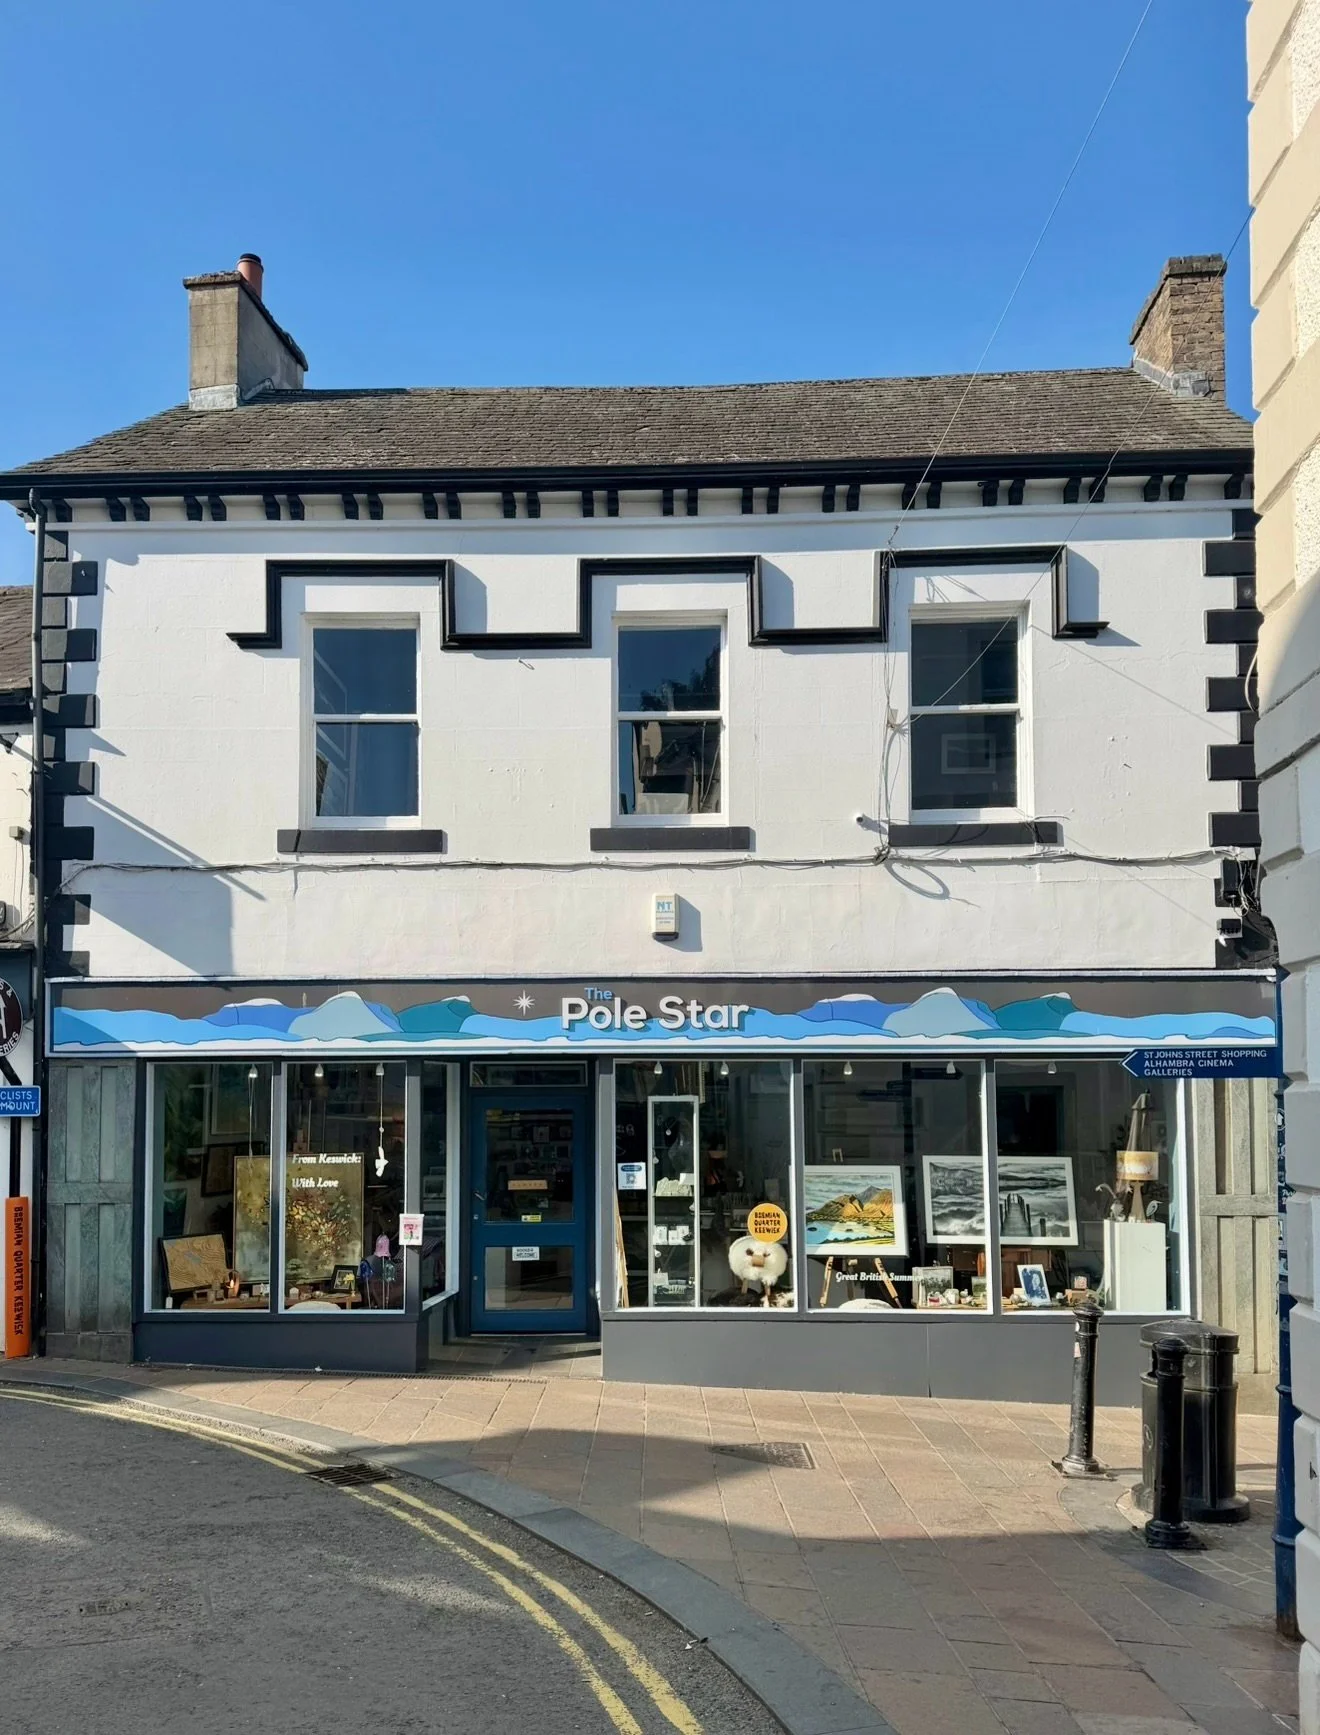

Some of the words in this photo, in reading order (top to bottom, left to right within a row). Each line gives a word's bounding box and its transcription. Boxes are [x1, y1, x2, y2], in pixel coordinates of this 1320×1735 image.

[584, 987, 613, 1000] The
[561, 996, 648, 1030] Pole
[658, 995, 750, 1030] Star
[1154, 1051, 1184, 1059] JOHNS
[1185, 1050, 1218, 1058] STREET
[1221, 1049, 1267, 1058] SHOPPING
[1143, 1059, 1195, 1068] ALHAMBRA
[1198, 1059, 1234, 1067] CINEMA
[1143, 1068, 1193, 1076] GALLERIES
[0, 1090, 33, 1100] CLISTS
[292, 1153, 317, 1164] From
[319, 1153, 361, 1164] Keswick:
[291, 1176, 316, 1188] With
[316, 1176, 339, 1188] Love
[13, 1250, 23, 1292] QUARTER
[835, 1272, 858, 1282] Great
